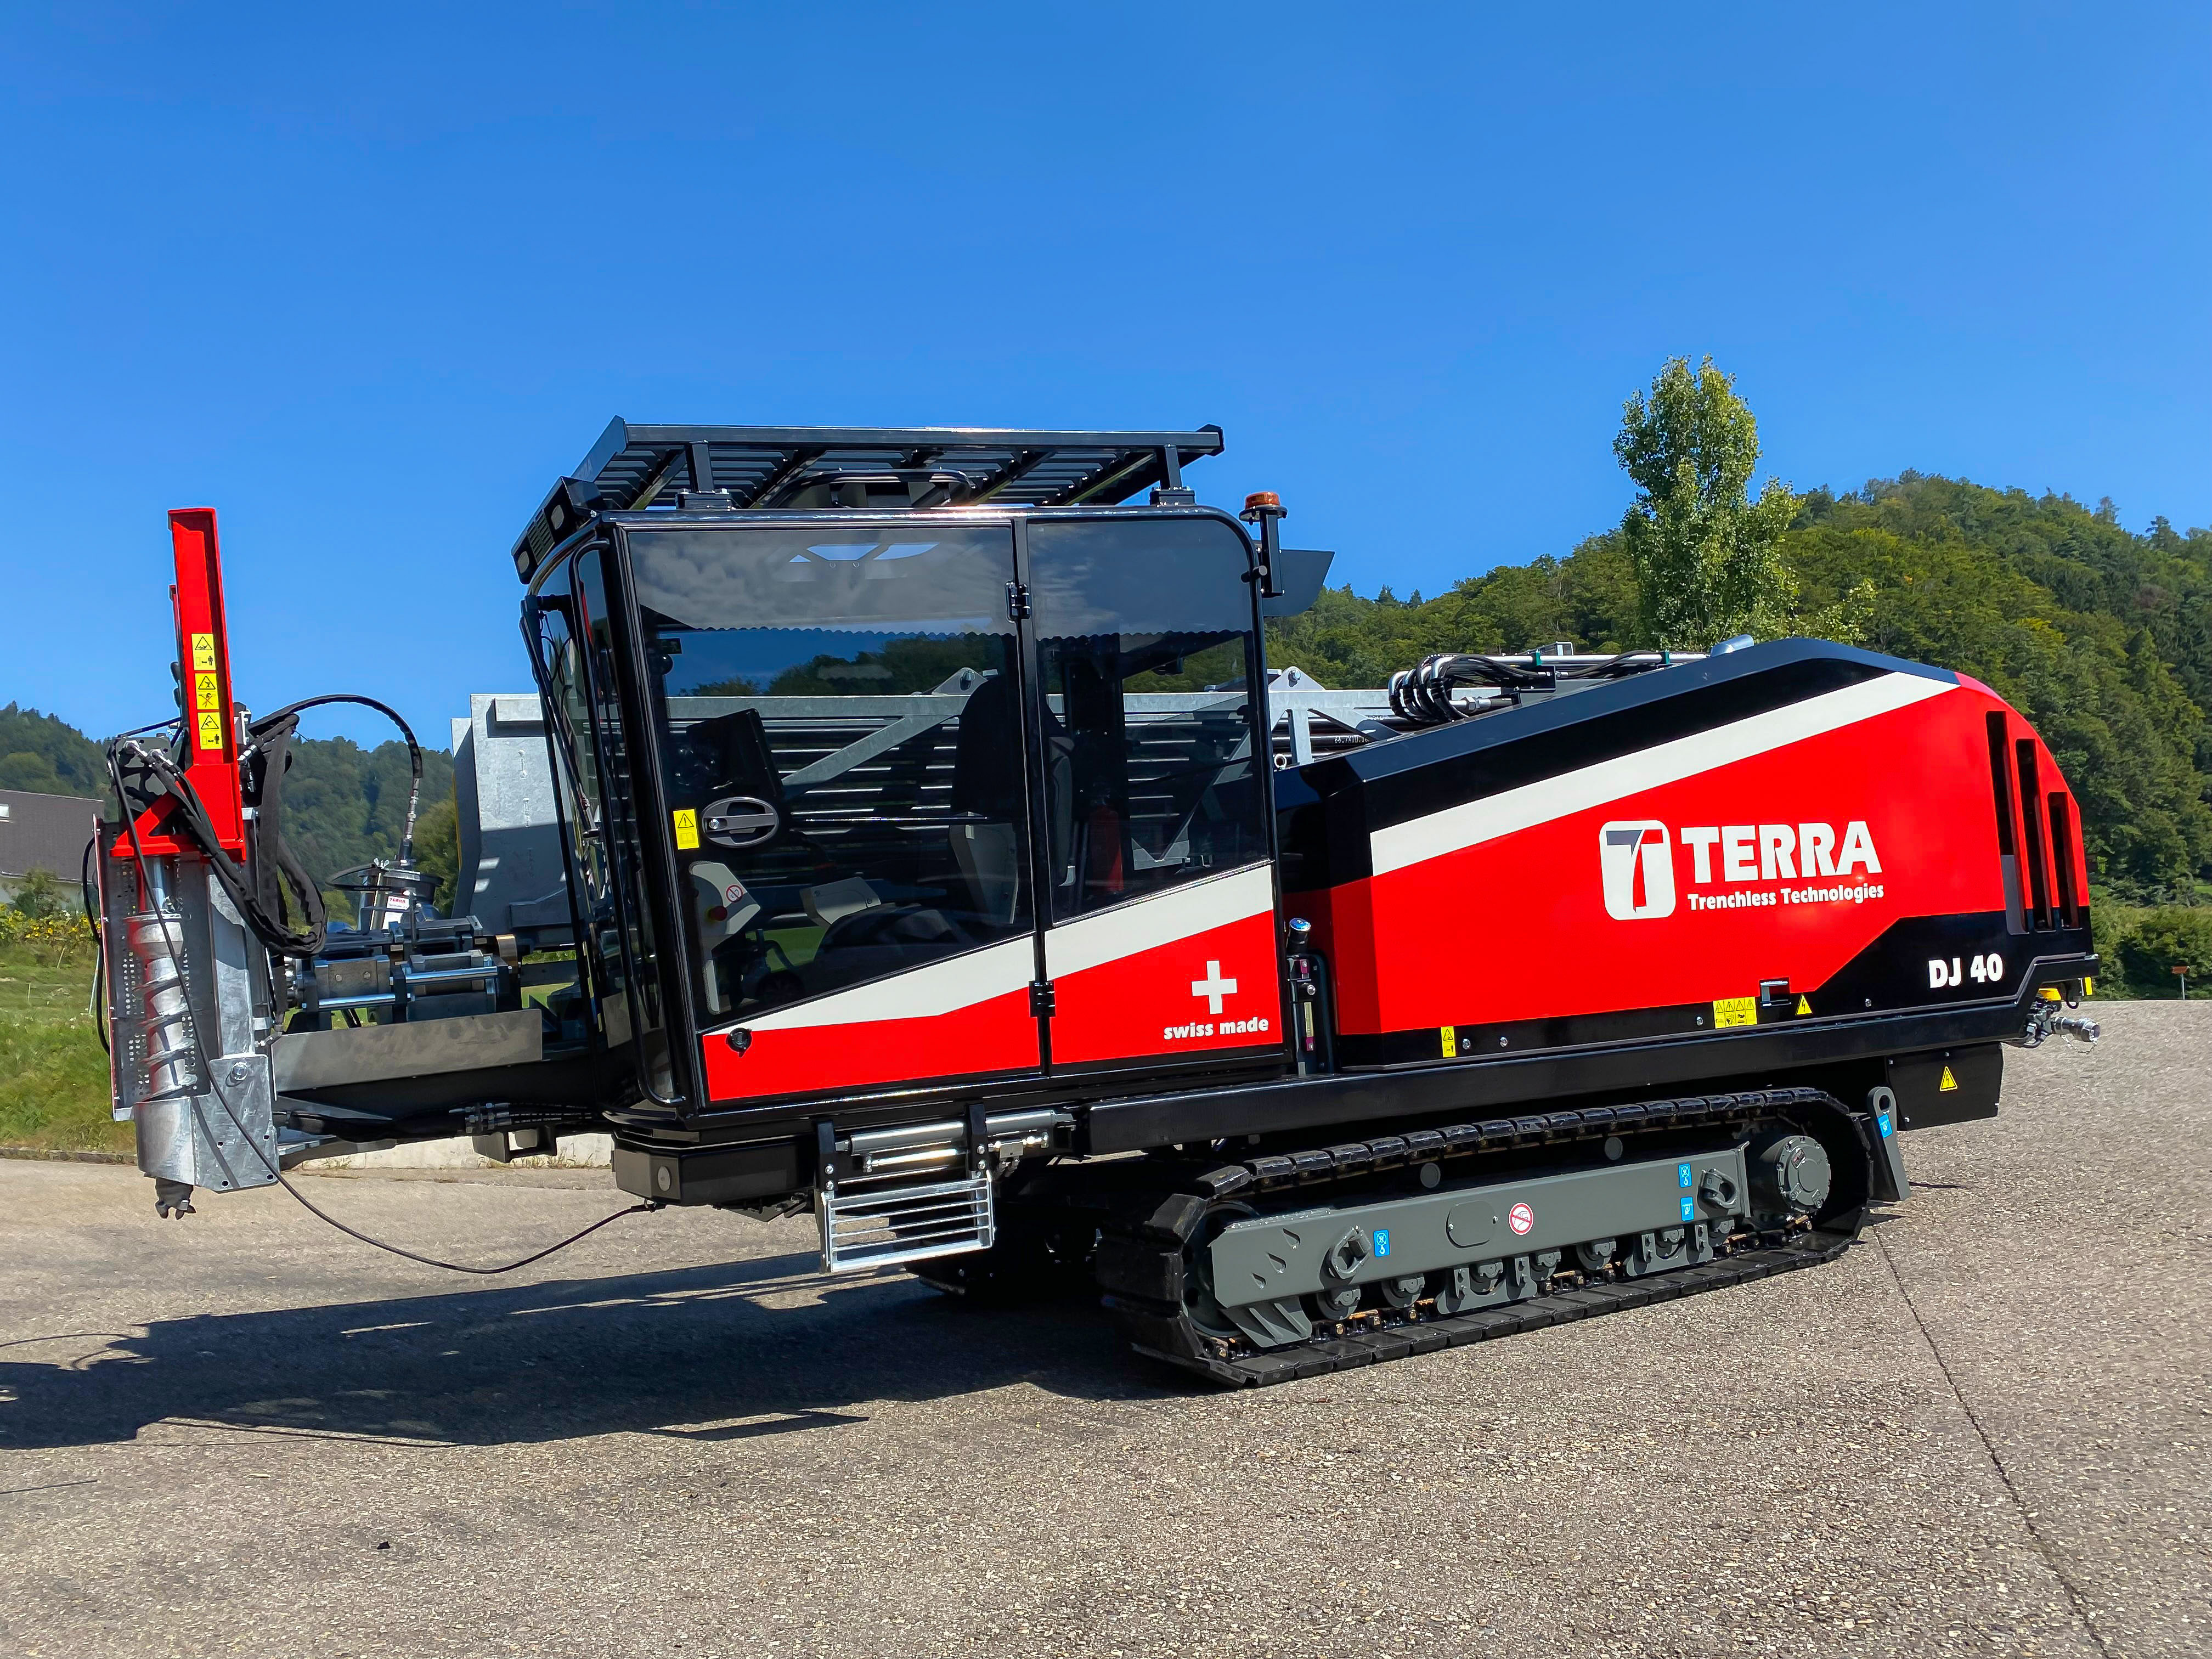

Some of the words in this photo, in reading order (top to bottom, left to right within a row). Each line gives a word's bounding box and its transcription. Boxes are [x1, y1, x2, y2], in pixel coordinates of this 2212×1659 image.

[1680, 821, 1883, 884] TERRA
[1687, 890, 1777, 911] Trenchless
[1780, 883, 1884, 904] Technologies
[1928, 957, 1961, 989] DJ
[1970, 953, 2003, 983] 40
[1164, 1022, 1214, 1040] swiss
[1220, 1017, 1269, 1035] made
